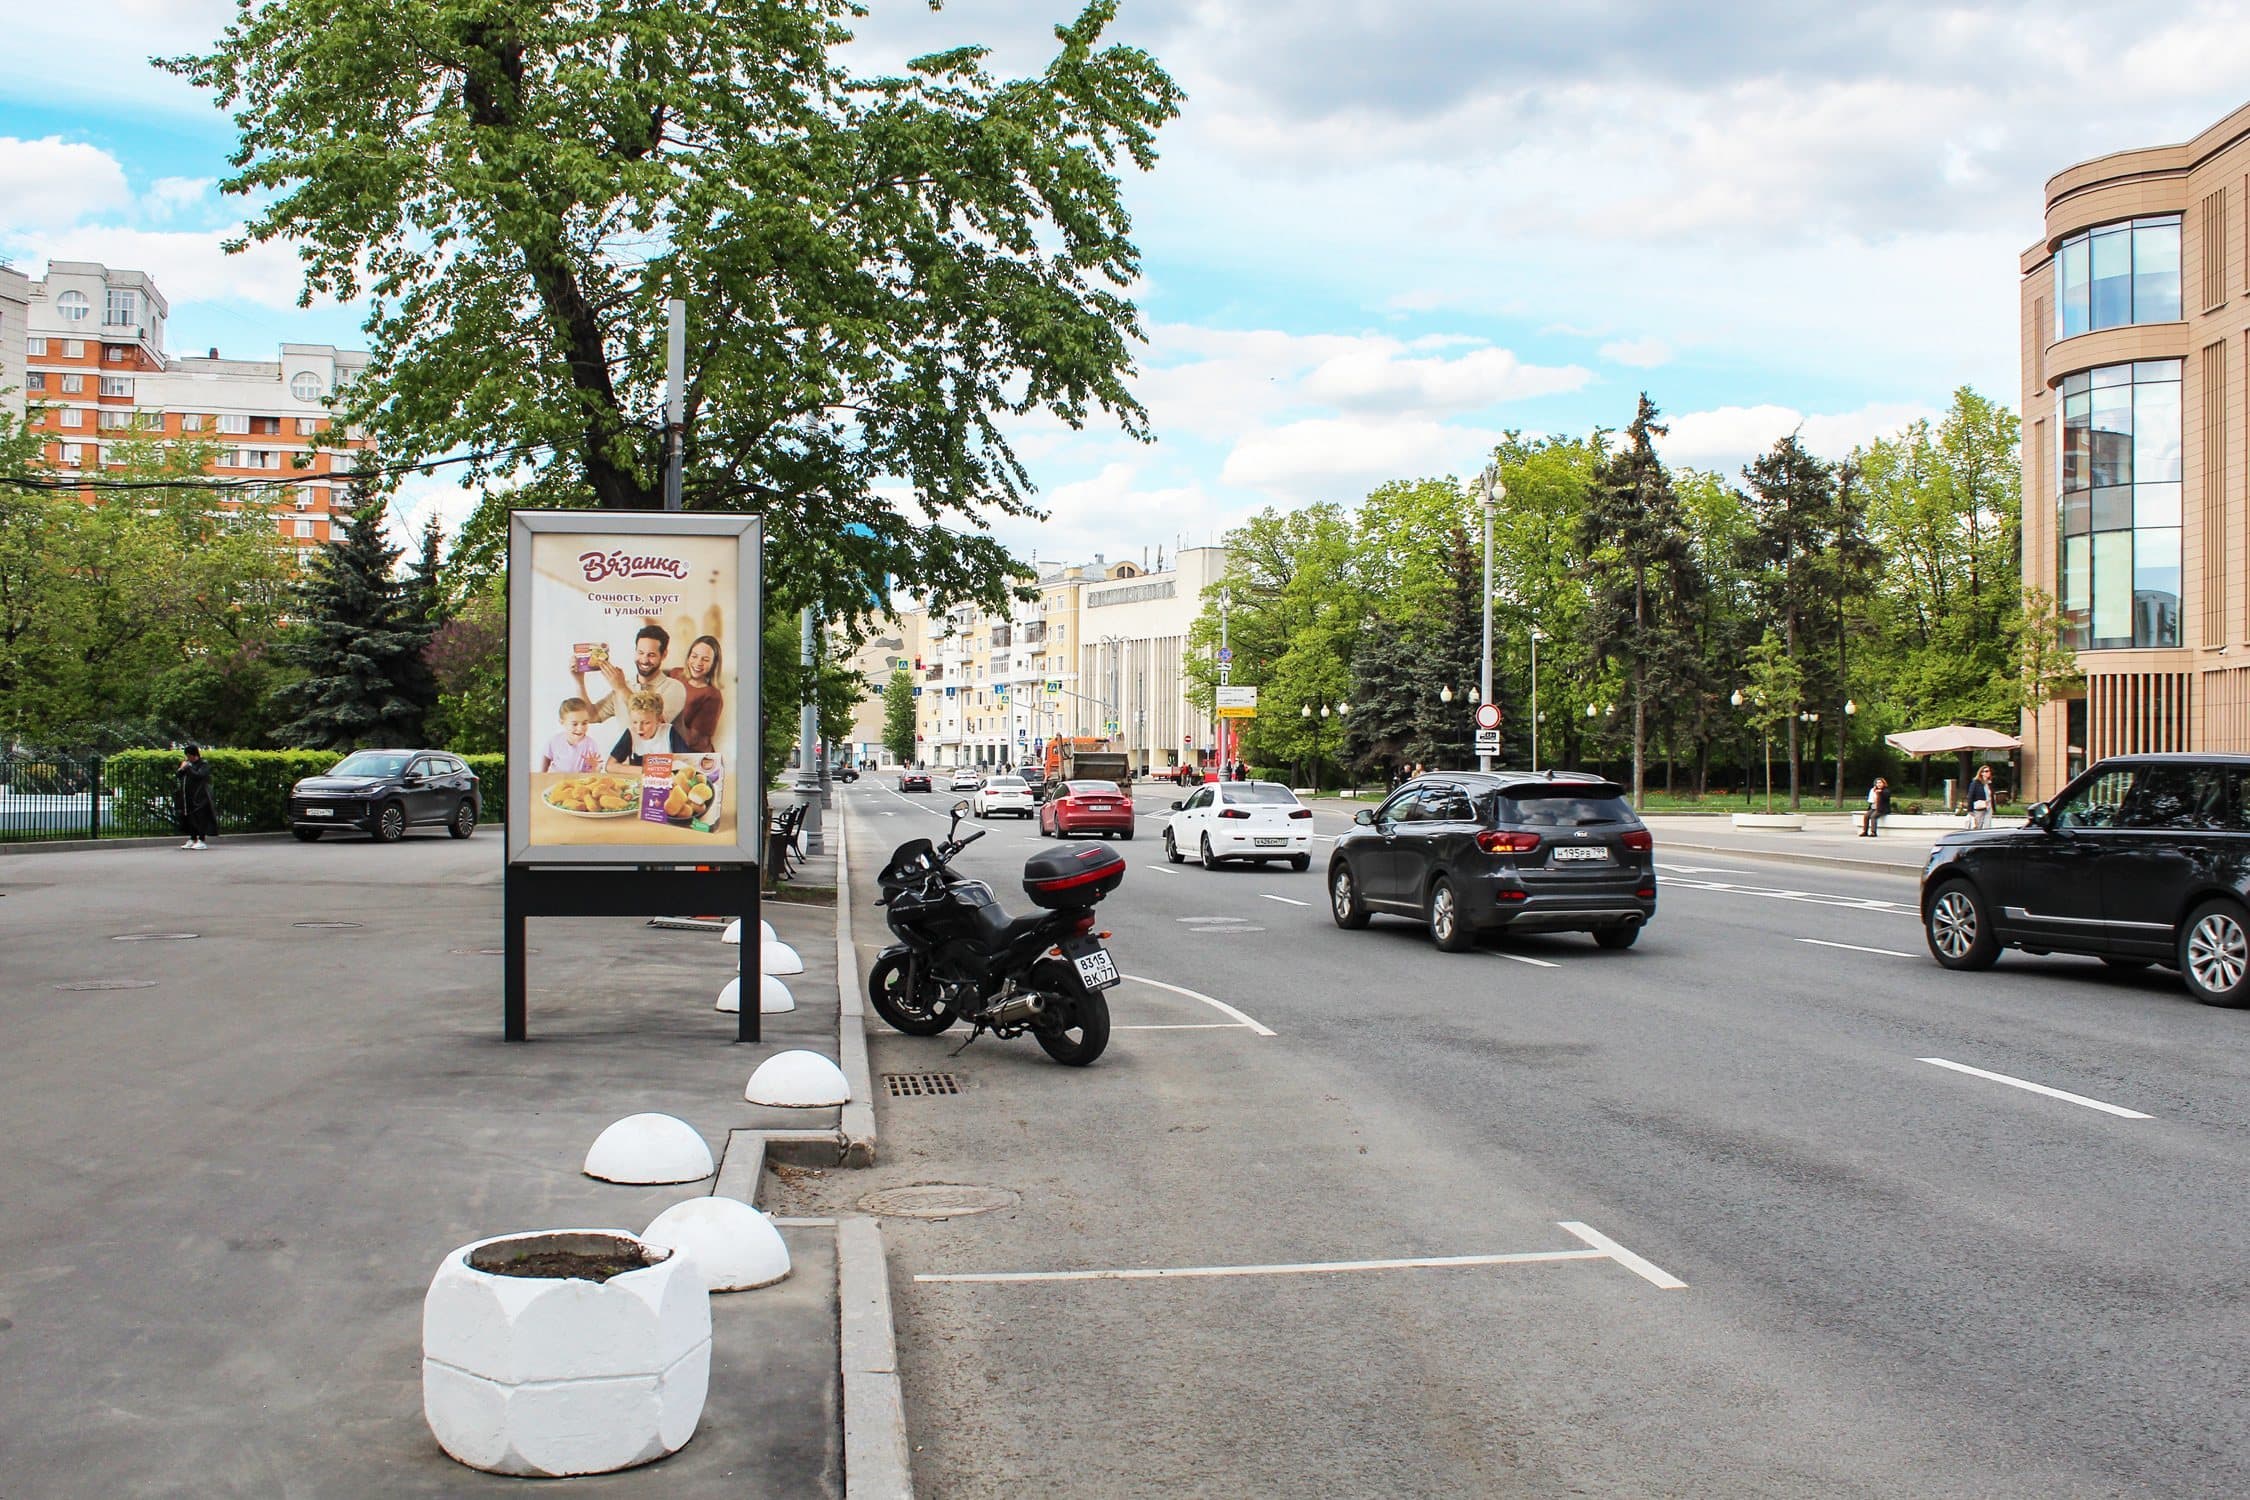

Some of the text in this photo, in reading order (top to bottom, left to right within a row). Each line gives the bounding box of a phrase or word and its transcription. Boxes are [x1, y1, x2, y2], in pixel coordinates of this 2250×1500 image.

[588, 592, 680, 604] Сочность, хруст
[604, 606, 663, 616] и улыбки!
[1080, 953, 1106, 970] 8315
